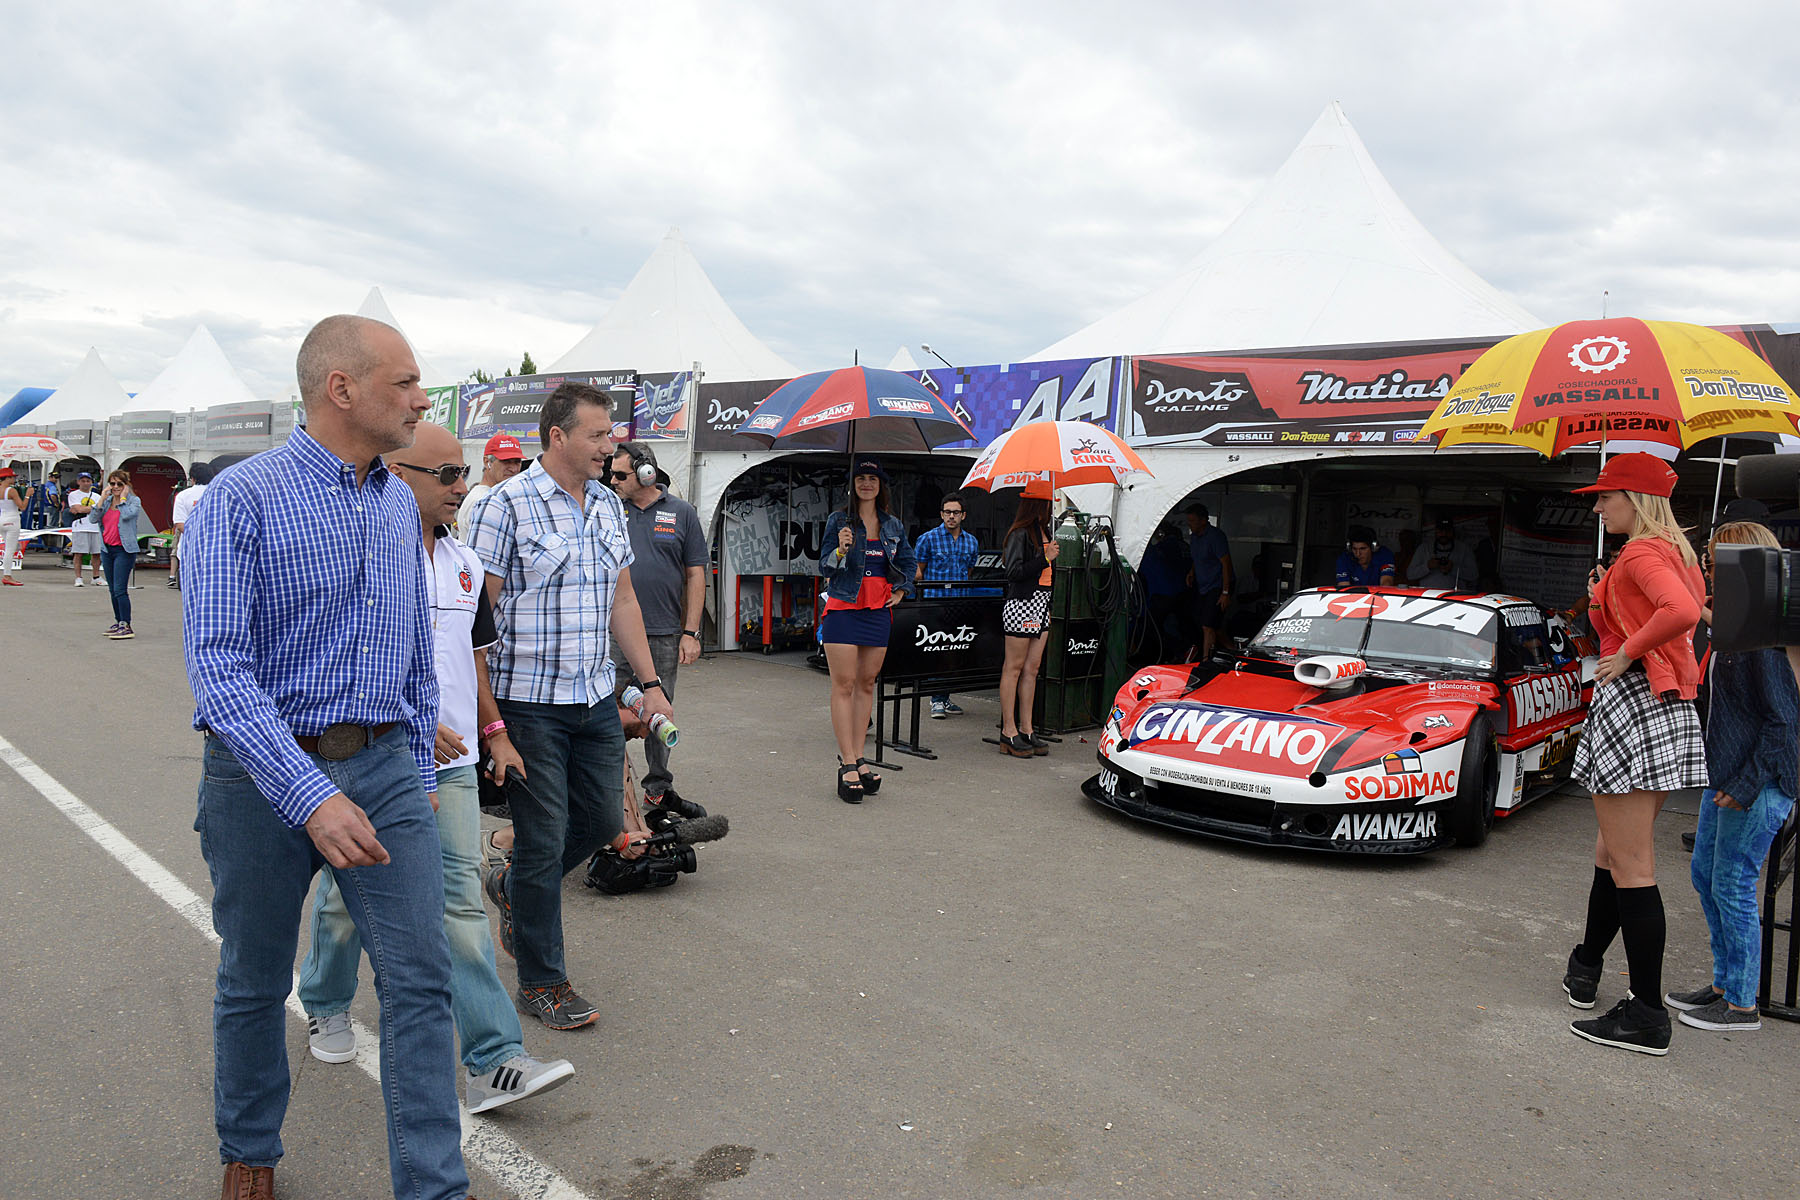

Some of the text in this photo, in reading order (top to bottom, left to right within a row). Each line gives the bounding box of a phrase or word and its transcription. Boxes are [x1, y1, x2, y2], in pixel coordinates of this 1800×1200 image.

[1145, 379, 1249, 405] Donto
[1303, 372, 1450, 401] Matias
[1558, 378, 1638, 390] COSECHADORAS
[1684, 376, 1791, 405] Don Roque
[1154, 404, 1230, 413] RACING
[1440, 391, 1516, 419] Don Roque
[1533, 387, 1660, 408] VASSALLI
[707, 398, 766, 424] Don
[244, 421, 264, 429] SILVA
[1226, 432, 1274, 442] VASSALLI
[1281, 432, 1302, 442] Don
[1300, 431, 1331, 443] Roque
[1334, 431, 1386, 442] NOVA
[1072, 455, 1116, 464] KING
[1267, 618, 1313, 629] SANCOR
[1273, 592, 1495, 636] NOVA
[915, 624, 978, 647] Donto
[1262, 625, 1311, 637] SEGUROS
[923, 643, 970, 652] RACING
[1135, 674, 1156, 687] 5
[1436, 682, 1481, 692] @dontoracing
[1136, 707, 1326, 766] CINZANO
[1149, 765, 1161, 776] BEBER
[1160, 768, 1168, 777] CON
[1208, 776, 1214, 786] SU
[1214, 778, 1227, 789] VENTA
[1230, 780, 1249, 793] MENORES
[1248, 784, 1255, 793] DE
[1260, 783, 1271, 796] AÑOS
[1344, 769, 1456, 801] SODIMAC
[1330, 810, 1437, 841] AVANZAR
